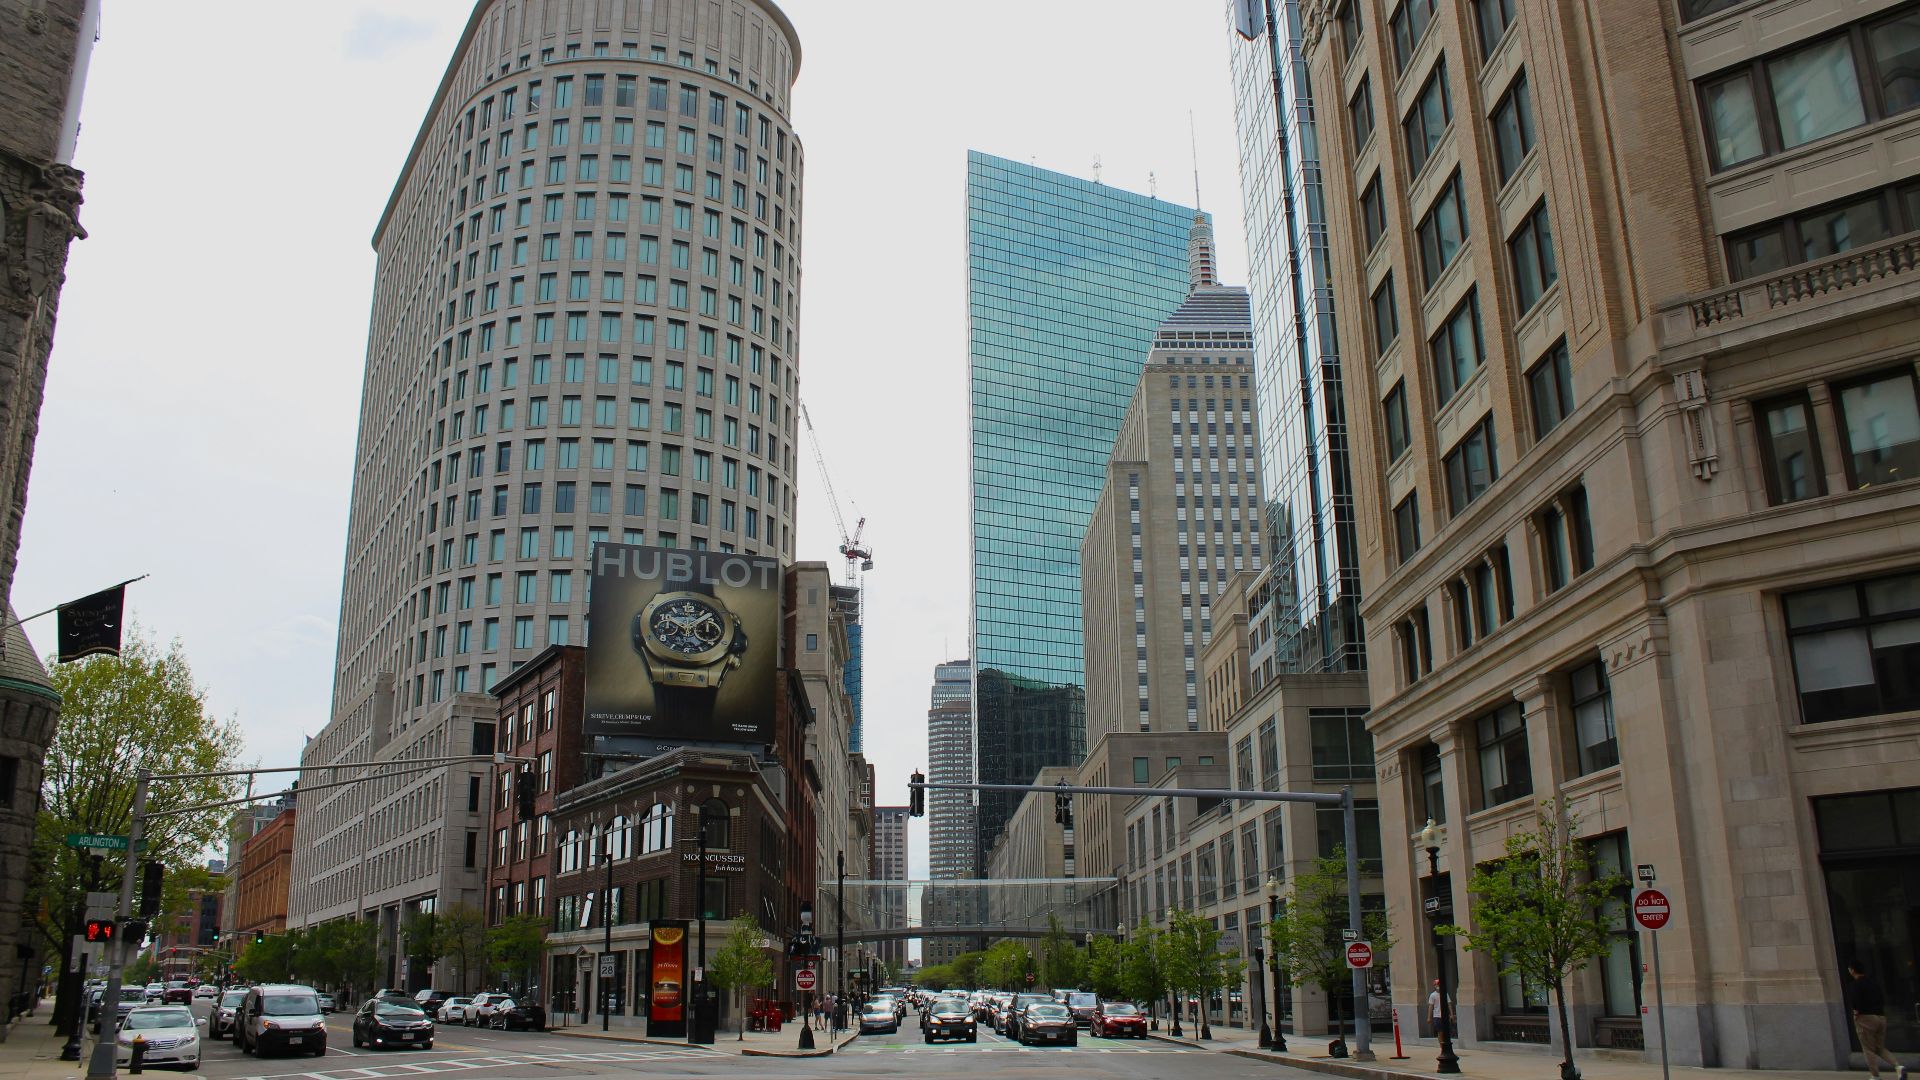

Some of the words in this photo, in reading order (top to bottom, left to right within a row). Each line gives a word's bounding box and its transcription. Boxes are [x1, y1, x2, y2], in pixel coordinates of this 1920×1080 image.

[597, 546, 777, 590] HUBLOT
[78, 835, 120, 848] ARLINGTON
[726, 864, 745, 872] house
[601, 965, 614, 975] 28
